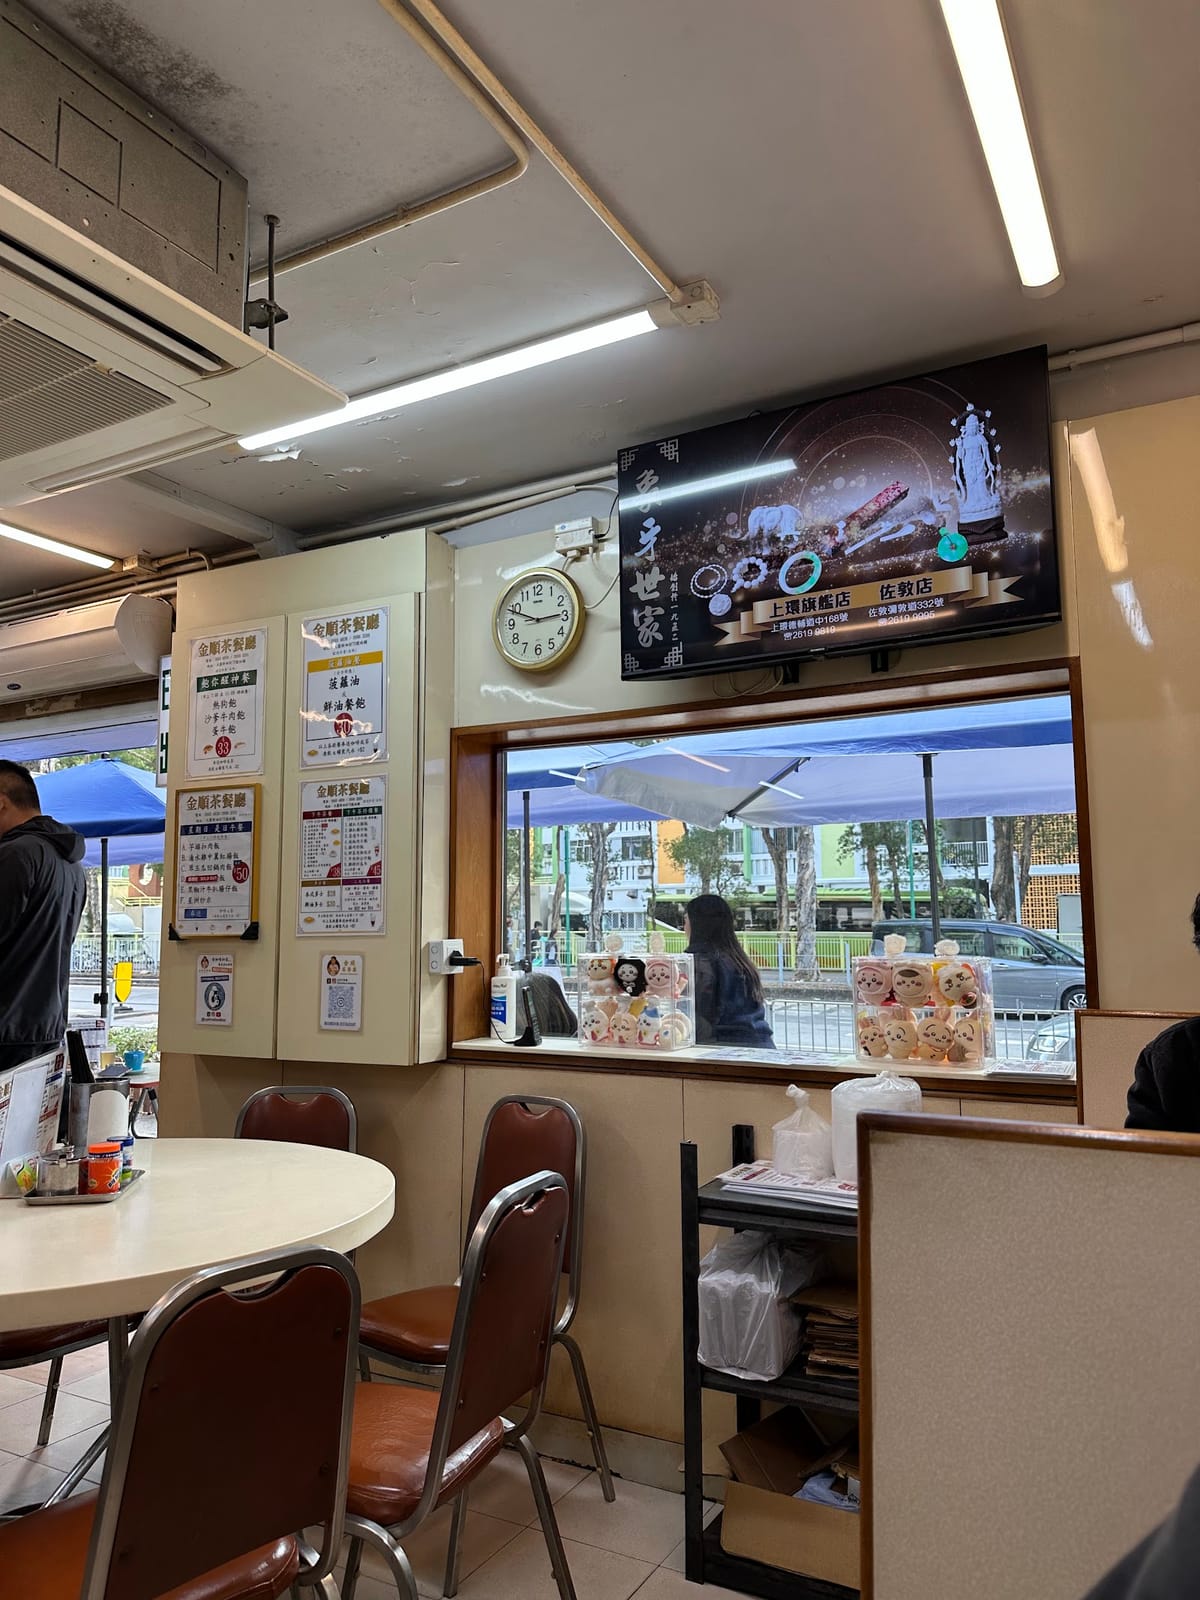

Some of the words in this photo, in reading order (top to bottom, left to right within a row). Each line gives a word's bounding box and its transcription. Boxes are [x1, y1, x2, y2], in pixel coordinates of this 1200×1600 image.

[521, 590, 529, 602] 11
[533, 584, 543, 597] 12
[557, 595, 564, 607] 2
[769, 591, 851, 618] 上環旗艦店
[880, 577, 932, 600] 佐敦店
[868, 597, 944, 618] 佐敦彌敦道332號
[561, 610, 569, 621] 3
[313, 613, 380, 638] 金順茶餐廳
[508, 619, 515, 630] 9
[557, 626, 564, 637] 4
[512, 633, 519, 644] 8
[548, 638, 555, 649] 5
[198, 635, 257, 657] 金順茶餐廳
[522, 642, 528, 654] 7
[534, 644, 542, 655] 6
[329, 675, 360, 690] 菠蘿油
[317, 782, 370, 798] 金順茶餐廳
[186, 791, 247, 811] 金順茶餐廳
